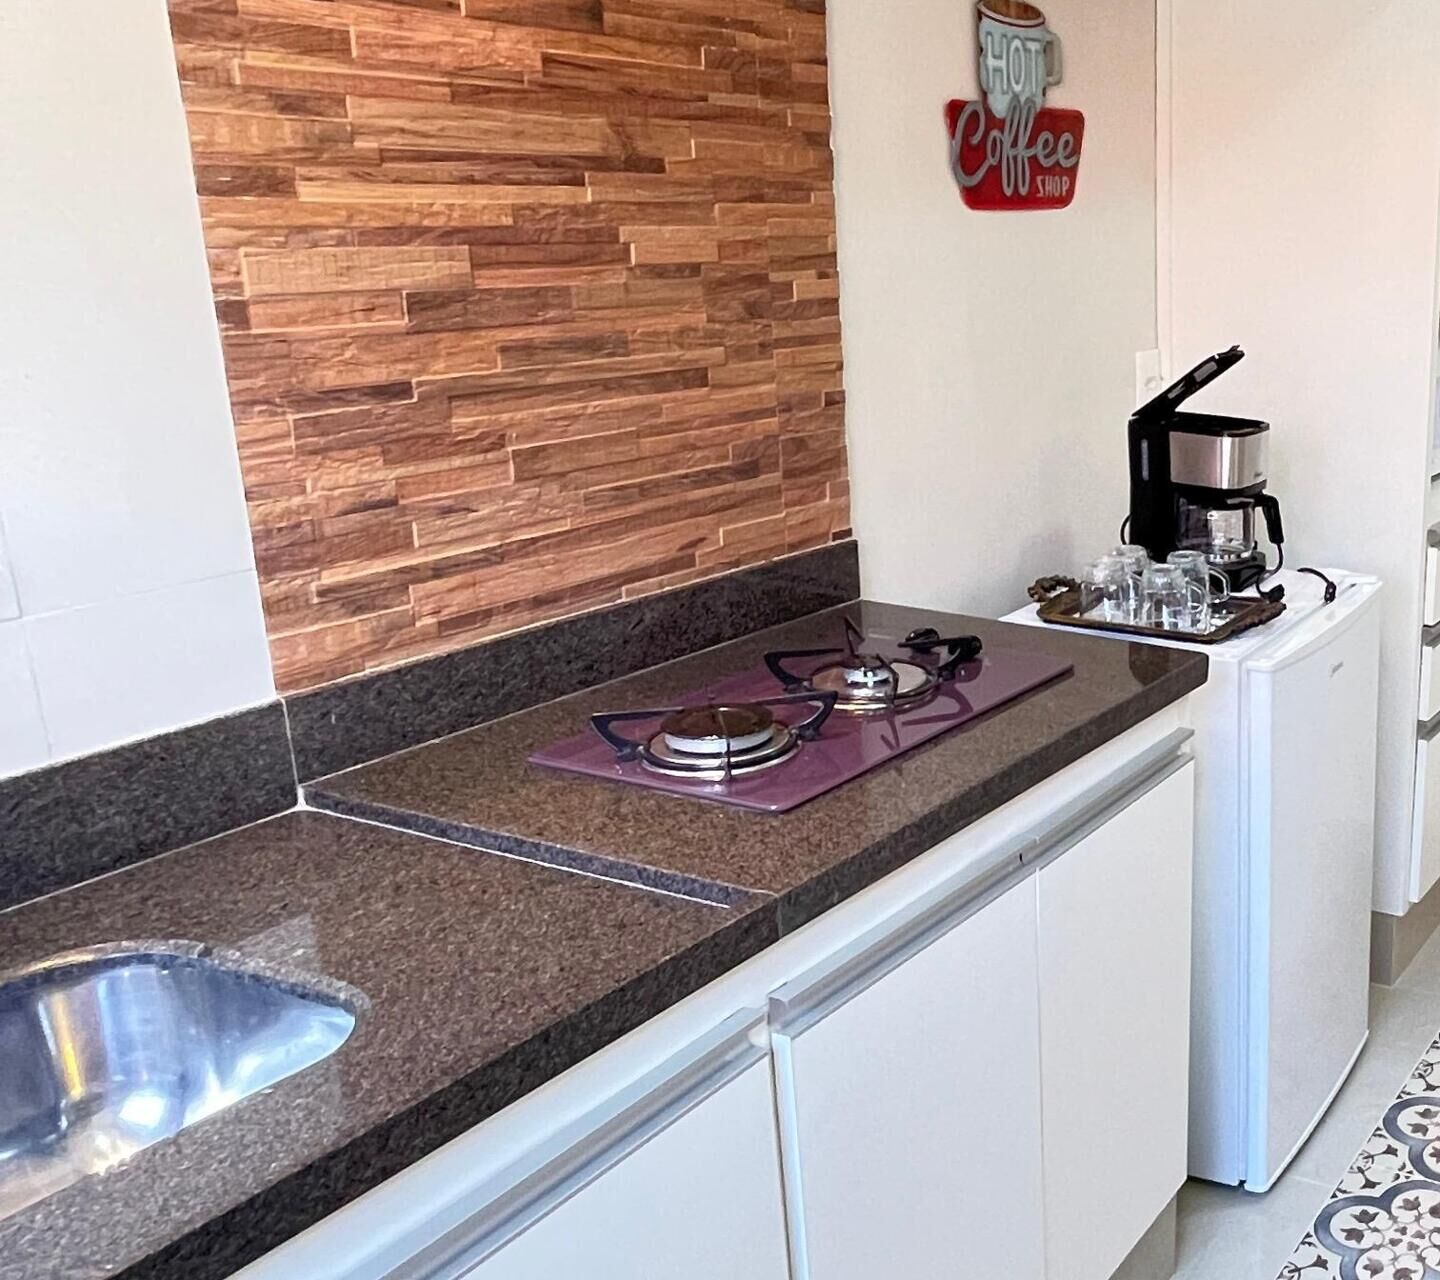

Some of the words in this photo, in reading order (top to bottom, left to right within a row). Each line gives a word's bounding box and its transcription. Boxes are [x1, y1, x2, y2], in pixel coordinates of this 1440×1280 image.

[985, 33, 1042, 95] HOT
[950, 95, 1081, 197] Coffee
[1036, 175, 1070, 198] SHOP
